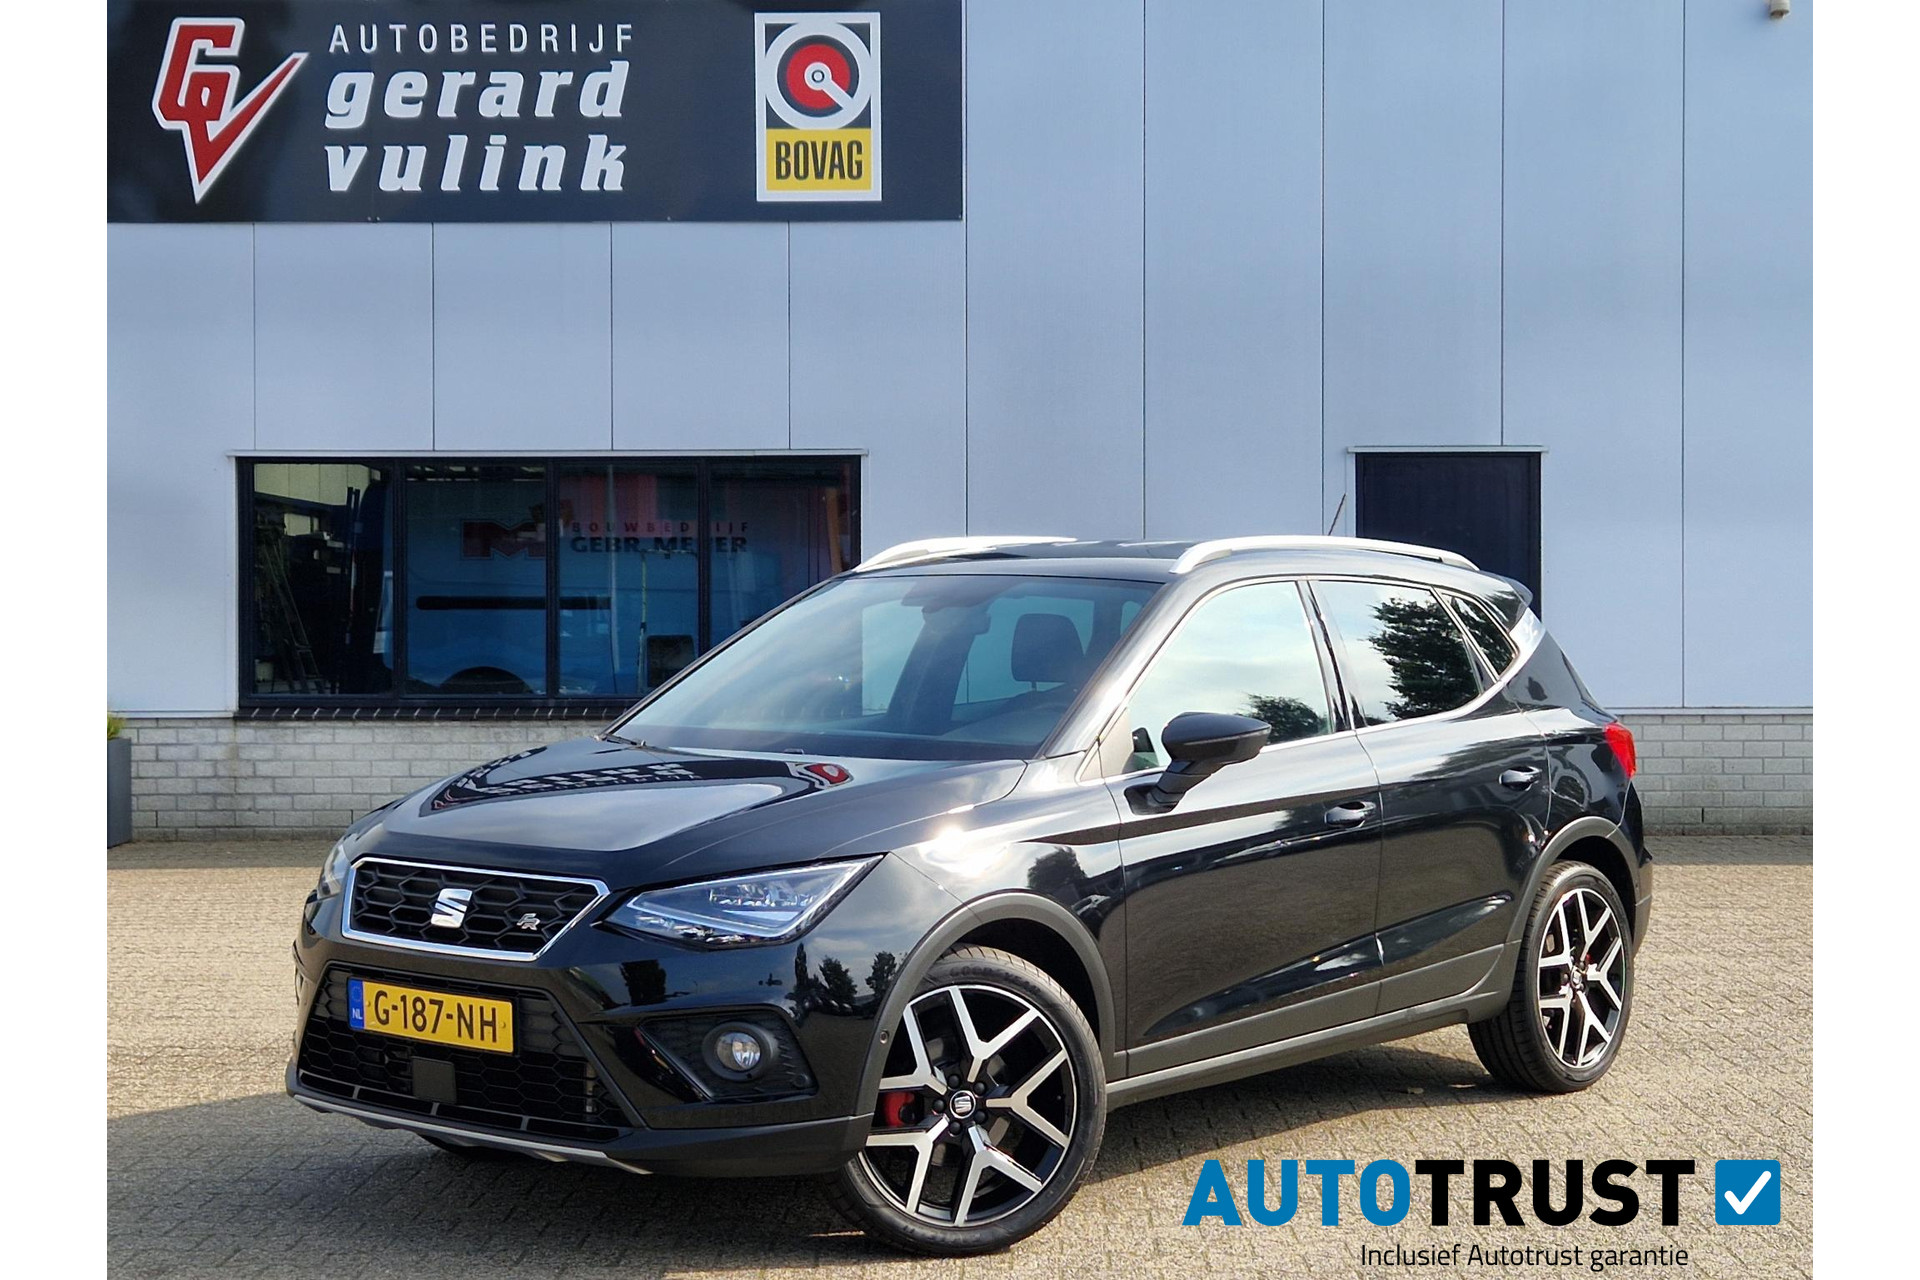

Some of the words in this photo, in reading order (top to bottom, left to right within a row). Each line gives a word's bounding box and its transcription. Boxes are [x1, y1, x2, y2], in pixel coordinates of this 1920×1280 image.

[328, 23, 633, 53] AUTOBEDRIJF
[325, 60, 630, 129] gerard
[325, 134, 627, 192] vulink
[775, 140, 863, 181] BOVAG
[572, 522, 748, 533] BOWBEDIJF
[352, 1007, 363, 1020] NL
[374, 990, 498, 1043] G-187-NH
